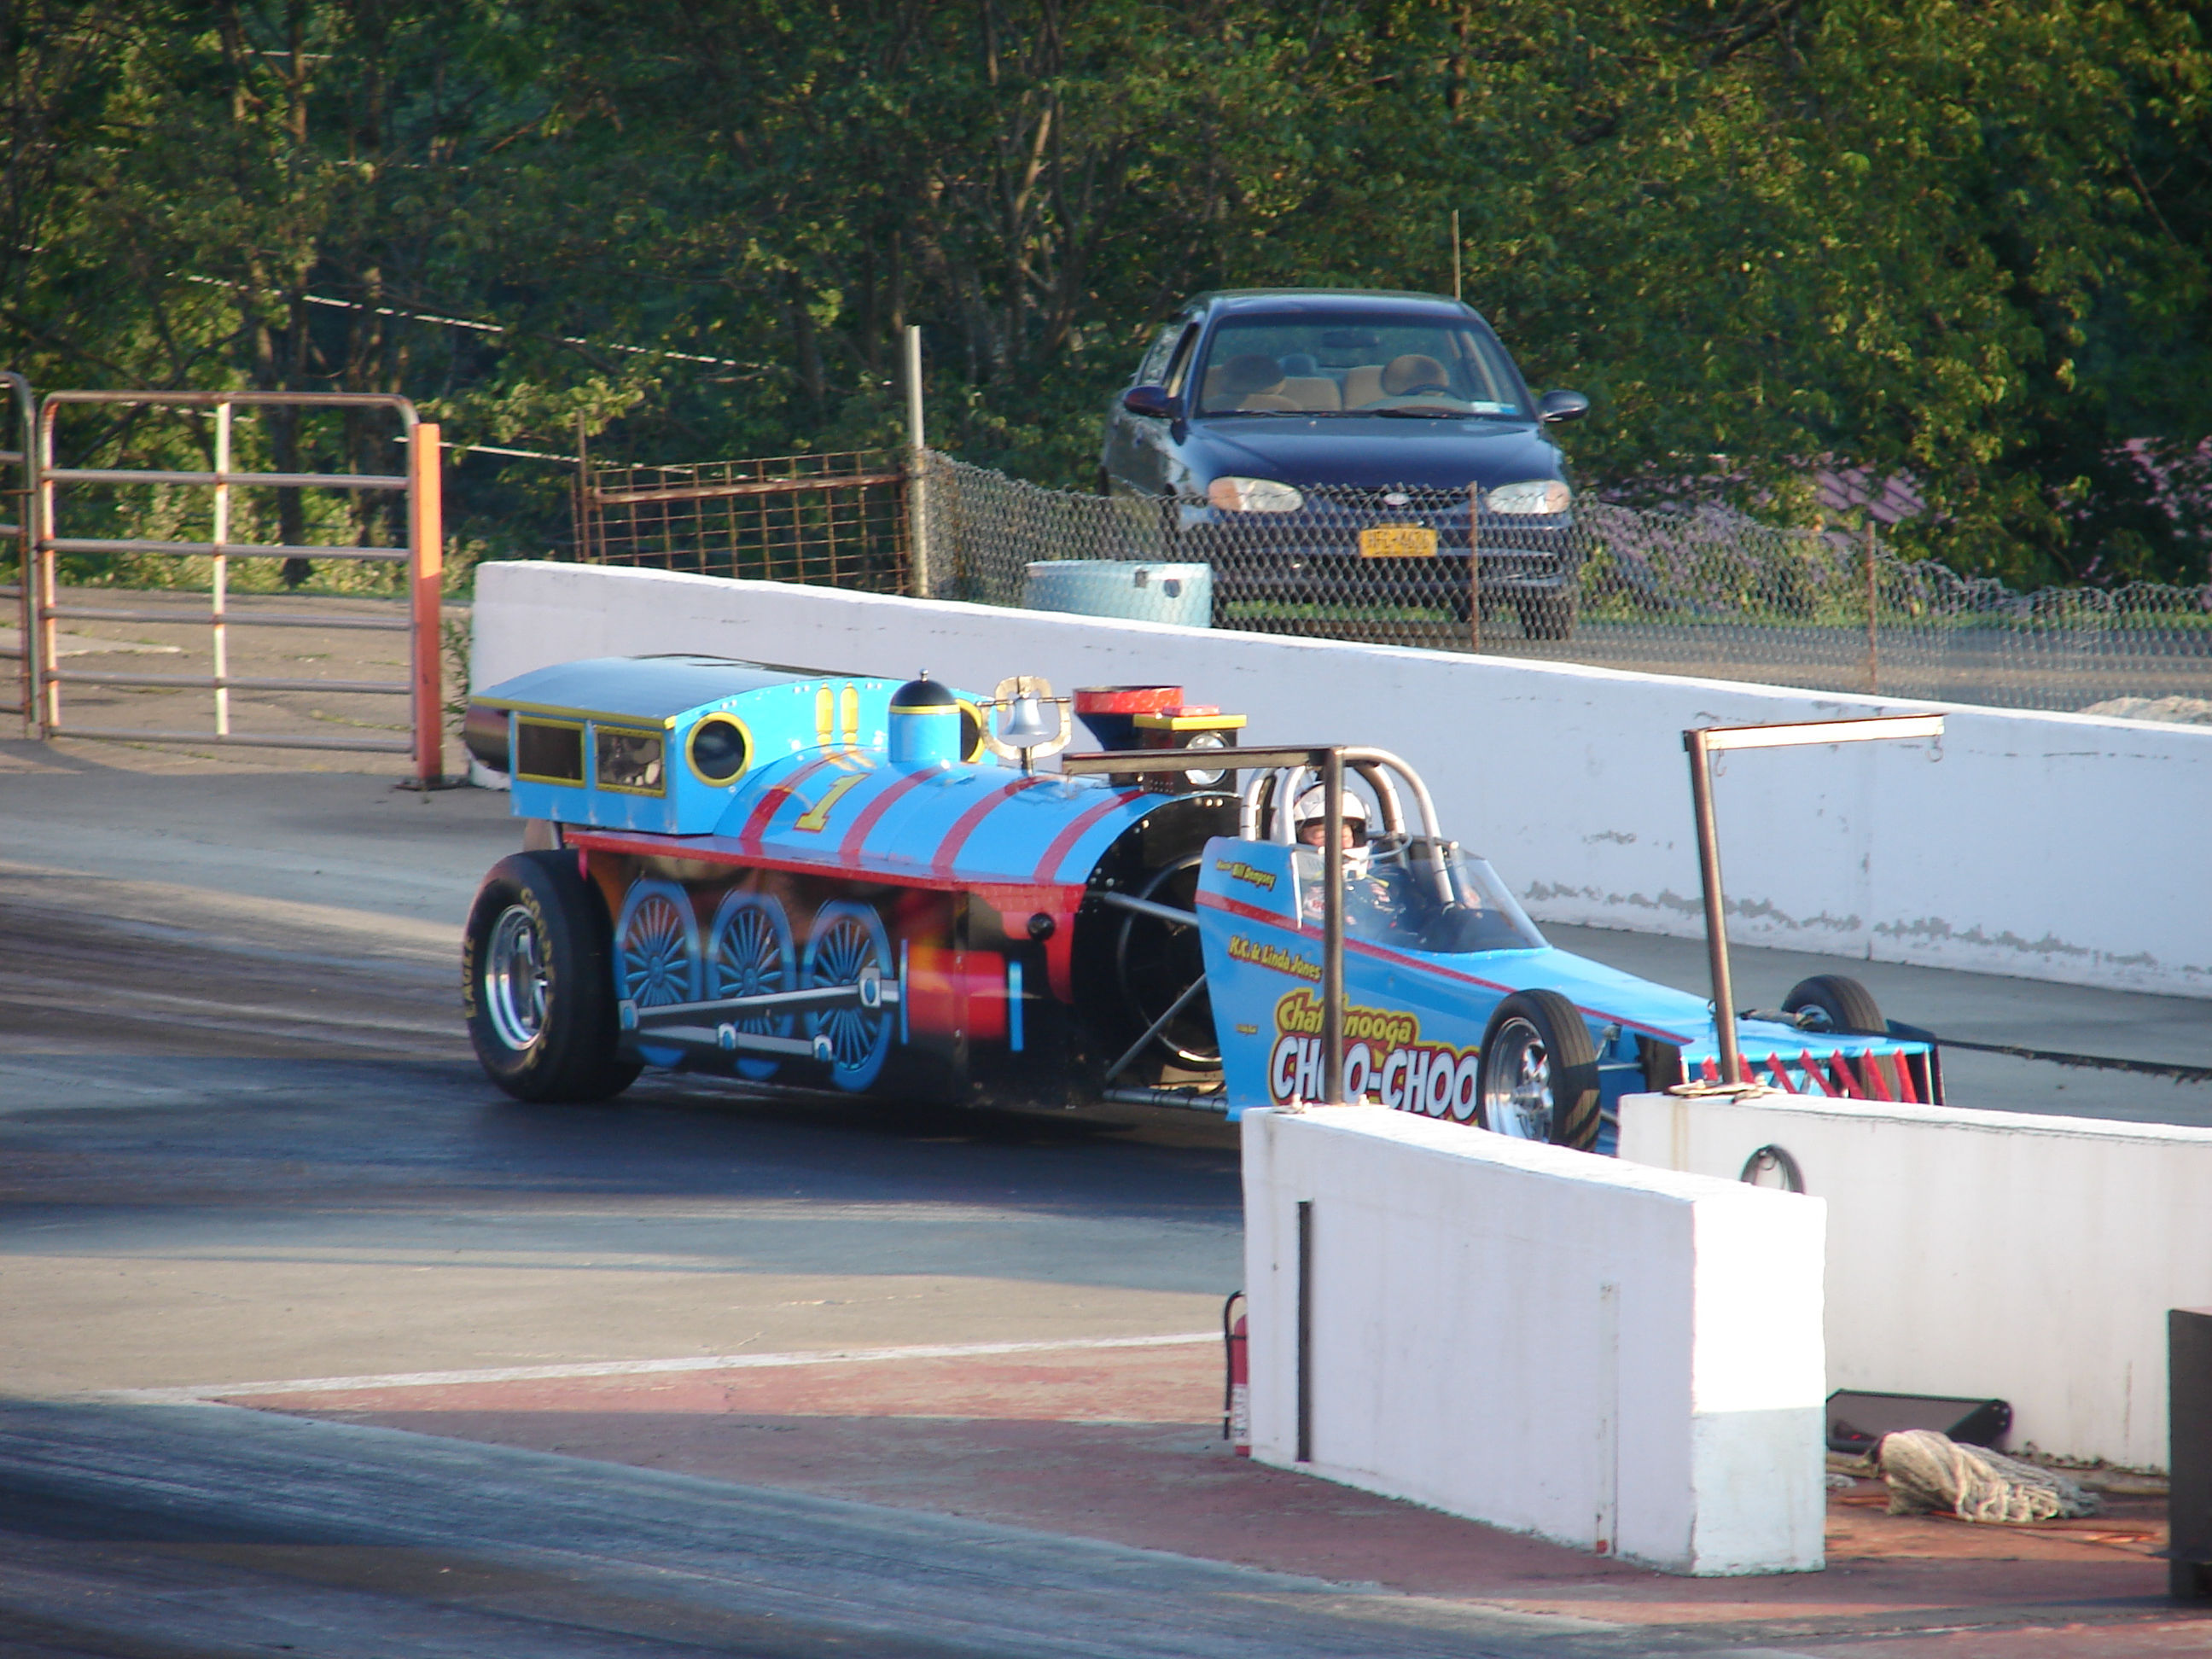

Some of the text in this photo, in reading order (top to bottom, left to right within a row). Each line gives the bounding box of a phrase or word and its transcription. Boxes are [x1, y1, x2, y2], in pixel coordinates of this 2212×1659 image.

[794, 772, 873, 833] 1
[1260, 945, 1291, 973] Linda
[1289, 953, 1323, 983] Jones
[1278, 996, 1413, 1053] Chatnooga
[1272, 1035, 1478, 1121] CHO-CHOO
